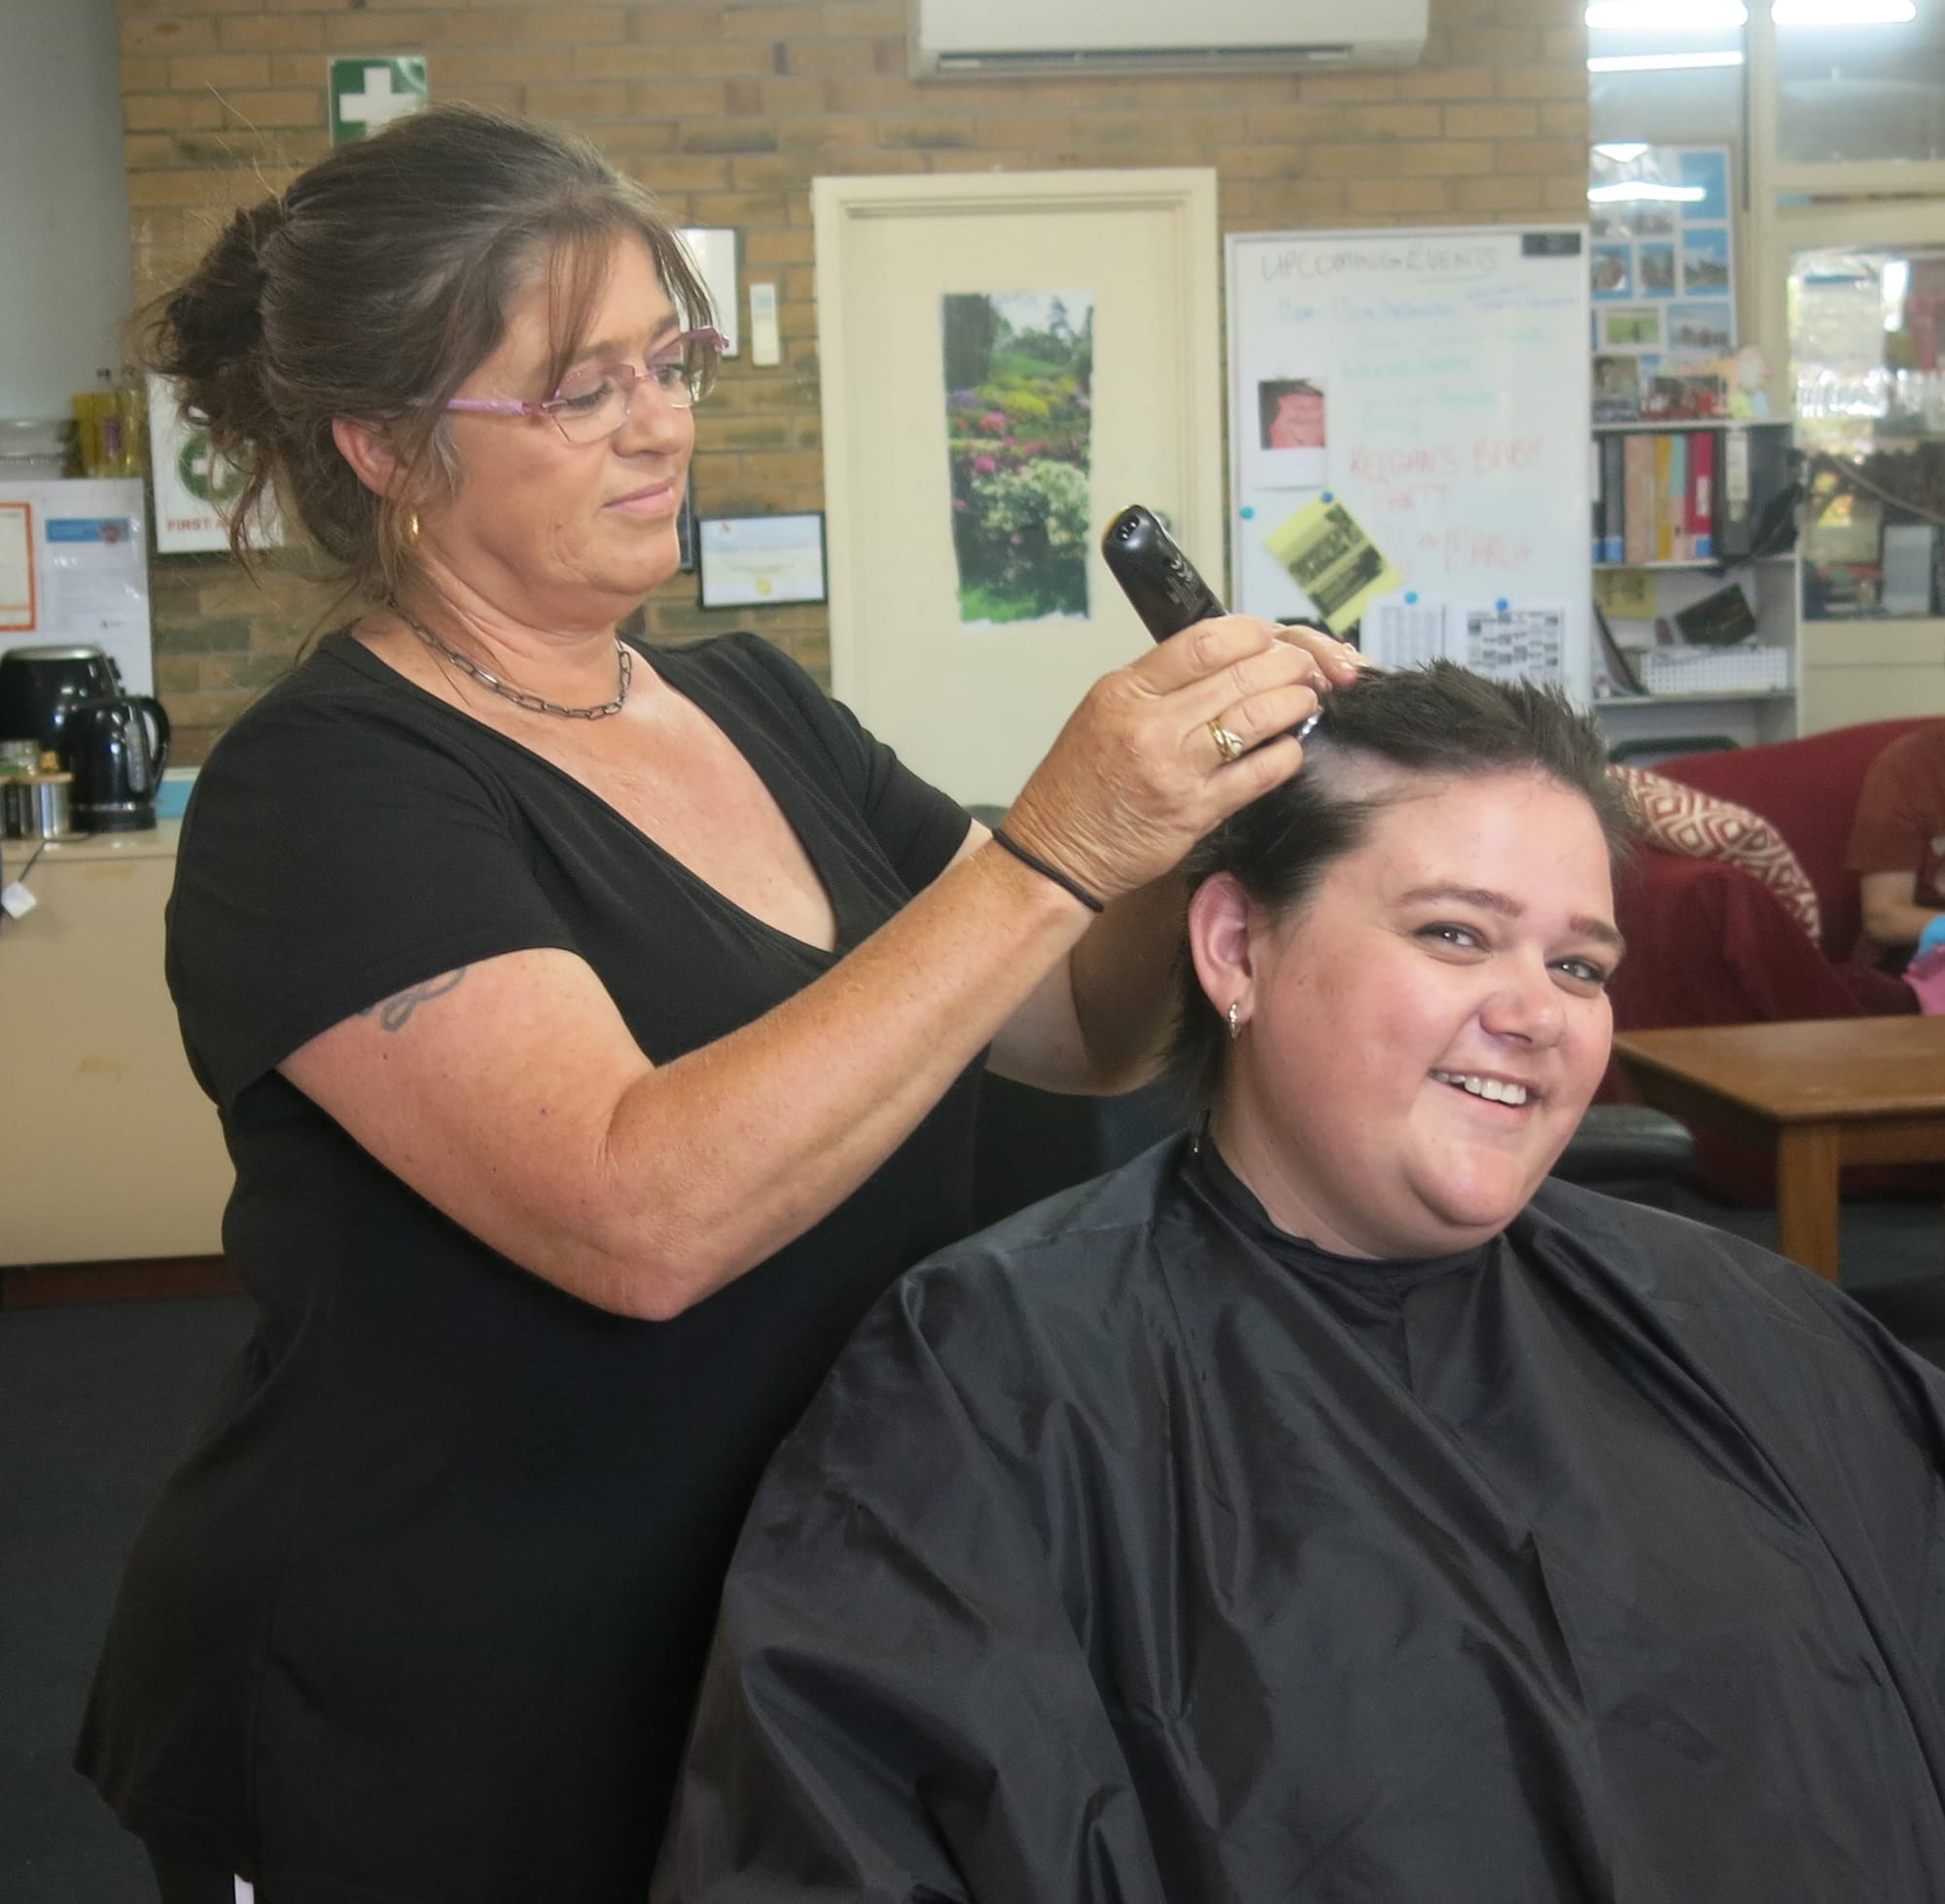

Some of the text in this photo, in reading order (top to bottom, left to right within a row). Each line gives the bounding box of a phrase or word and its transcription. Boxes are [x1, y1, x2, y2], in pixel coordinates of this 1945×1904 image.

[1260, 243, 1500, 282] UPCOMING EVENTS
[166, 516, 211, 532] FIRST
